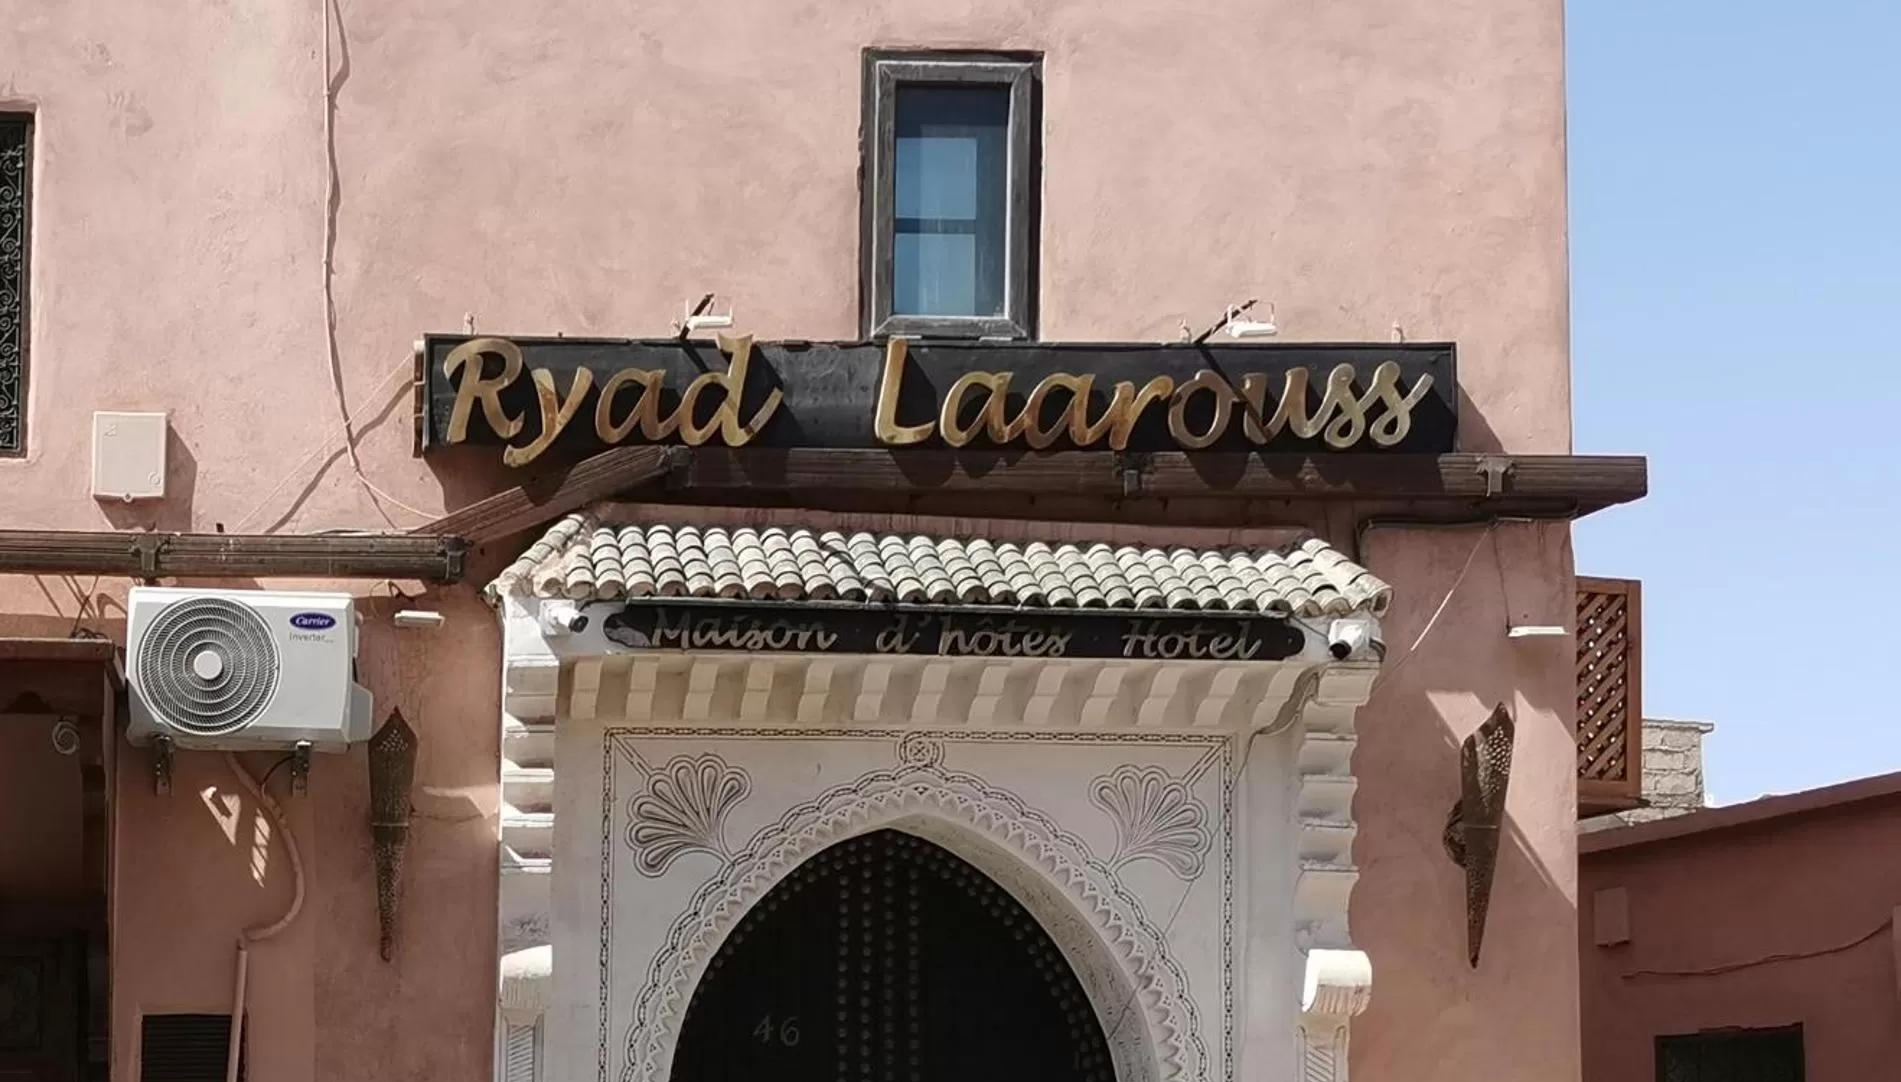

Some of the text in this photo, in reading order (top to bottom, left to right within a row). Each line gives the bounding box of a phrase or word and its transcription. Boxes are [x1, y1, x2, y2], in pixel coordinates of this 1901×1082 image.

[443, 333, 1435, 468] Ryad Laarouss
[289, 632, 326, 641] Inverter
[295, 616, 331, 626] Carrier
[651, 605, 837, 650] Maison
[1120, 618, 1263, 659] Hotel
[752, 1014, 800, 1047] 46
